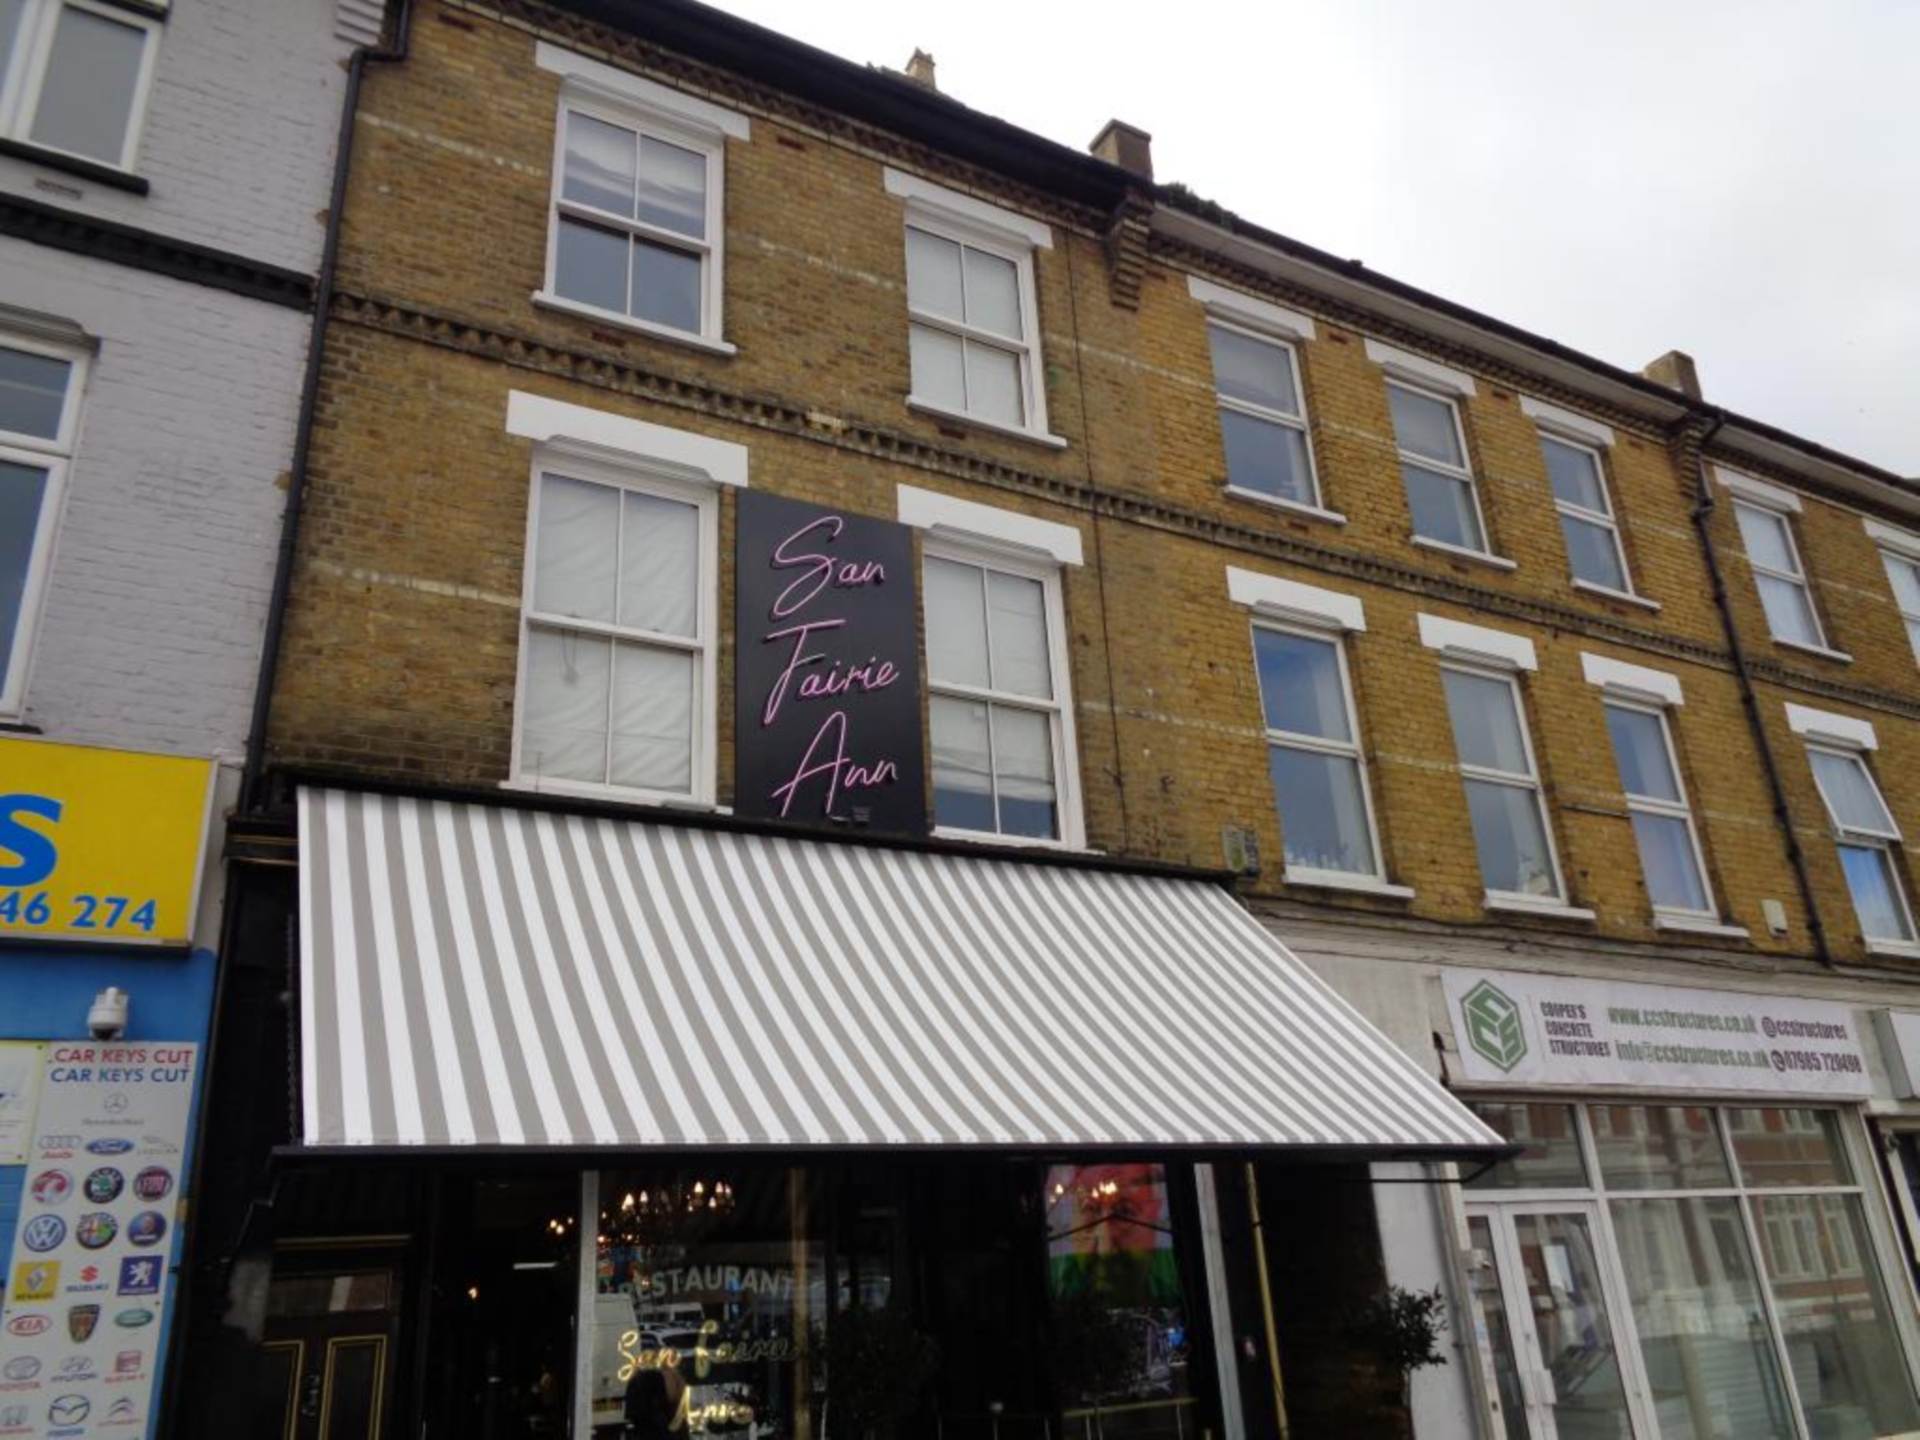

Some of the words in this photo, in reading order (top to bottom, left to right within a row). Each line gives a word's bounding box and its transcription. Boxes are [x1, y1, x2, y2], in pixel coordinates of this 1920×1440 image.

[772, 515, 886, 617] San
[763, 619, 899, 726] Fairie
[770, 711, 898, 818] Ann
[70, 895, 157, 932] 274
[1545, 1021, 1594, 1038] CONCRETE
[54, 1048, 96, 1063] CAR
[101, 1049, 147, 1063] KEYS
[153, 1050, 193, 1066] CUT
[1549, 1039, 1612, 1058] STRUCTURES
[51, 1068, 92, 1082] CAR
[98, 1068, 144, 1082] KEYS
[151, 1069, 190, 1082] CUT
[15, 1320, 44, 1331] KIA
